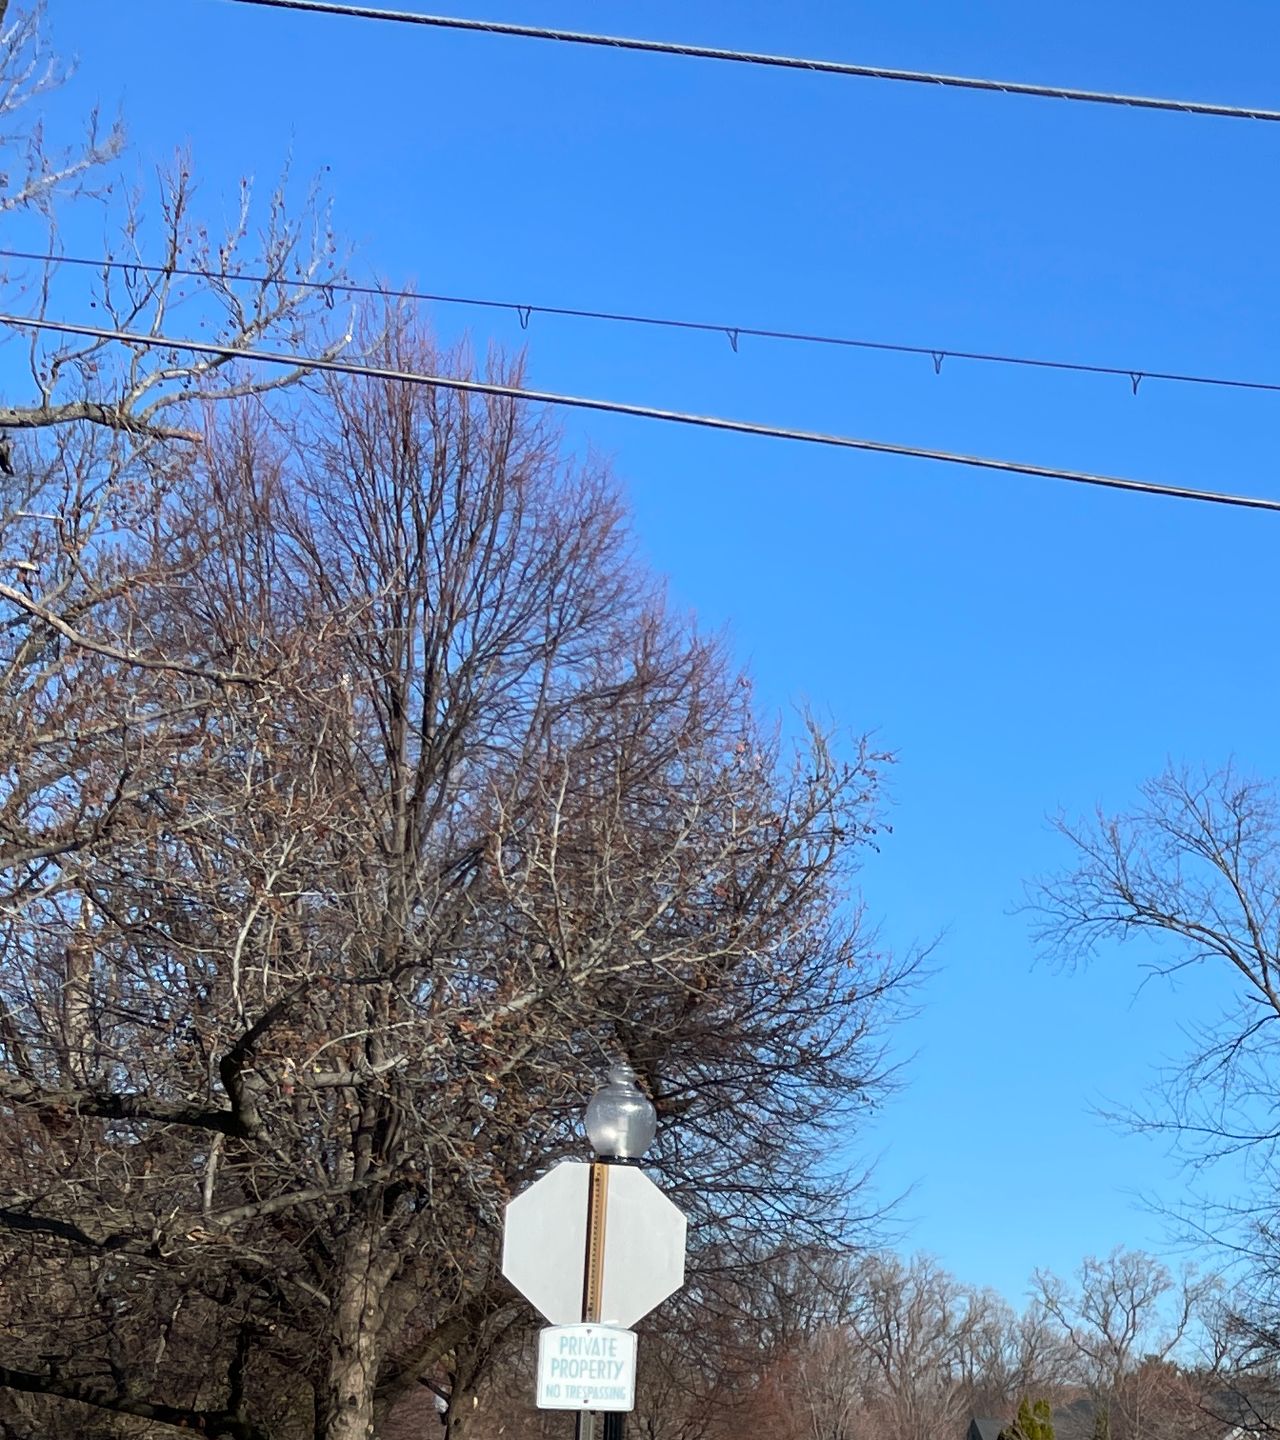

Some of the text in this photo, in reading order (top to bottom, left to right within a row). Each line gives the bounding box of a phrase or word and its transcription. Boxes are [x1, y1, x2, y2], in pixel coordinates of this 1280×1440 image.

[559, 1336, 617, 1357] PRIVATE
[551, 1358, 624, 1379] PROPERTY
[546, 1384, 626, 1400] NO TRESPASSING
